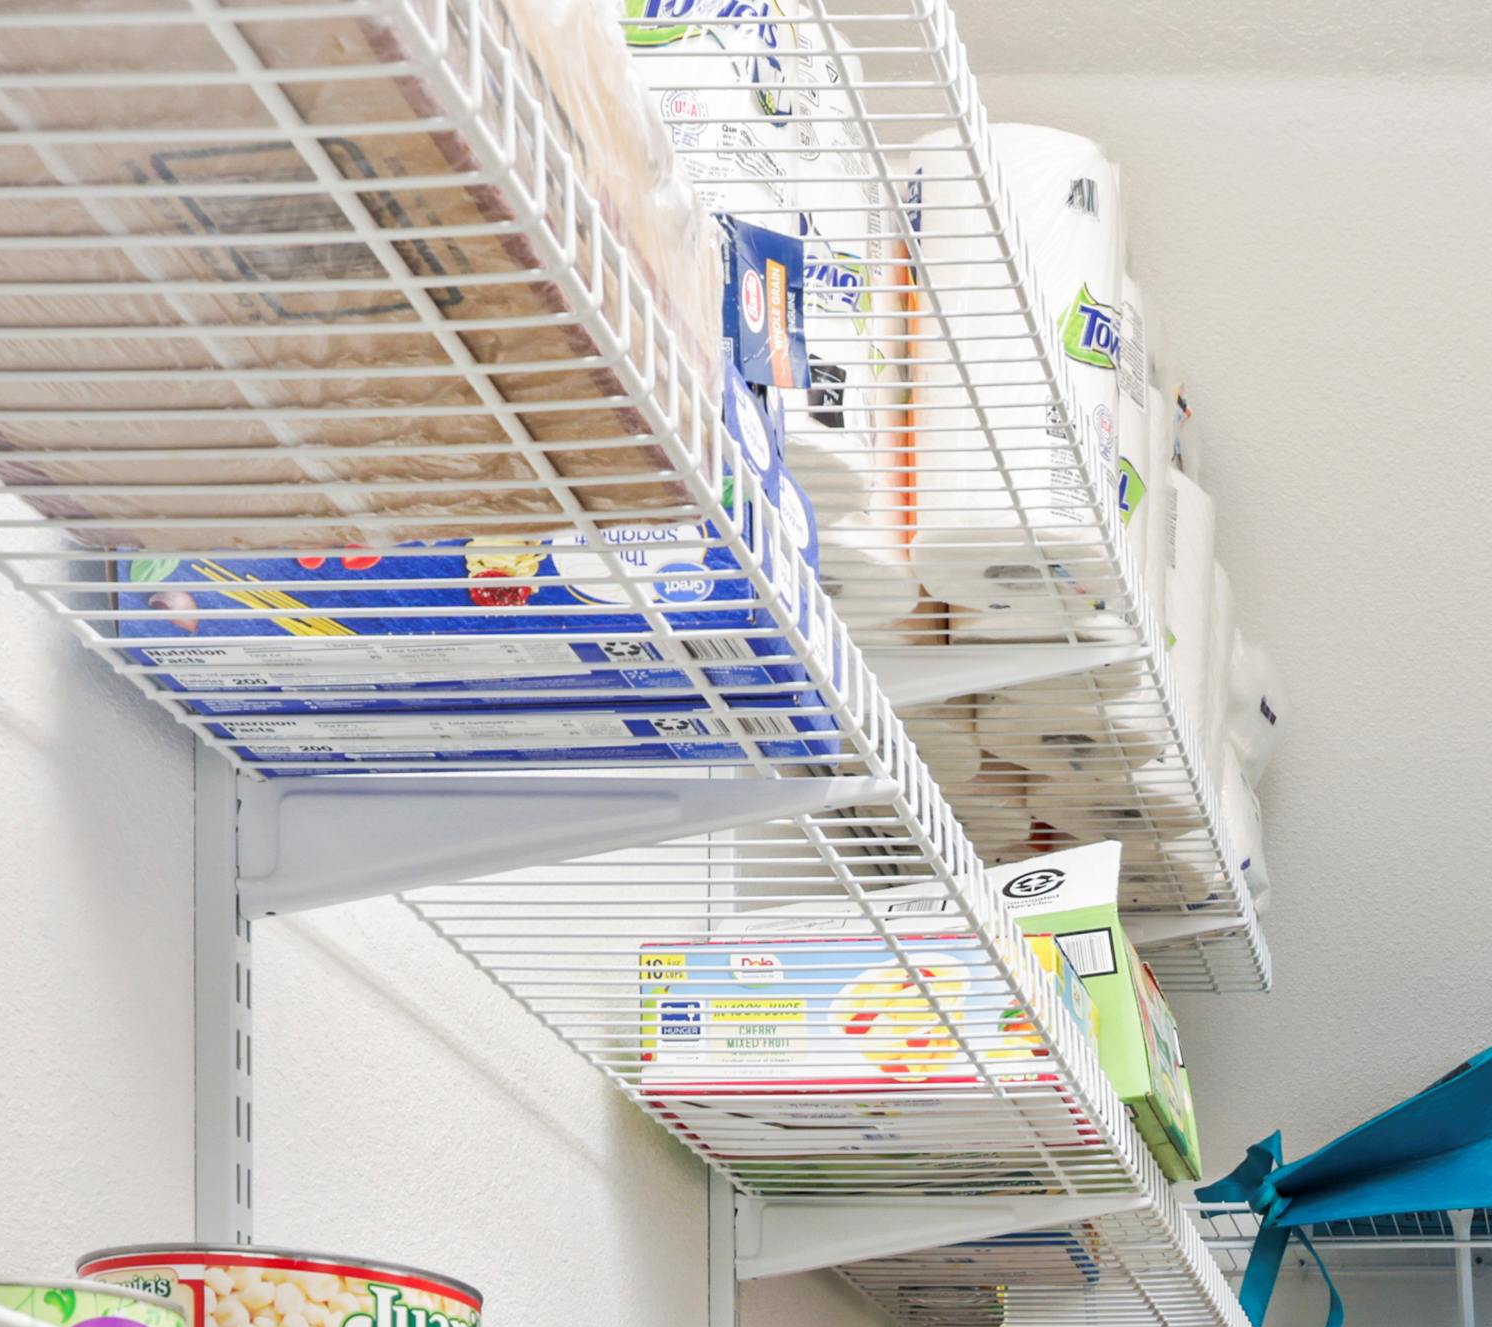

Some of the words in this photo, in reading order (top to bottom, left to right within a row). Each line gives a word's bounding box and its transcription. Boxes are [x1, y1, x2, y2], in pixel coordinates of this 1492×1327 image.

[772, 267, 781, 305] GRAIN
[146, 647, 227, 658] Nutrition
[156, 656, 206, 665] Facts
[231, 677, 269, 686] 200
